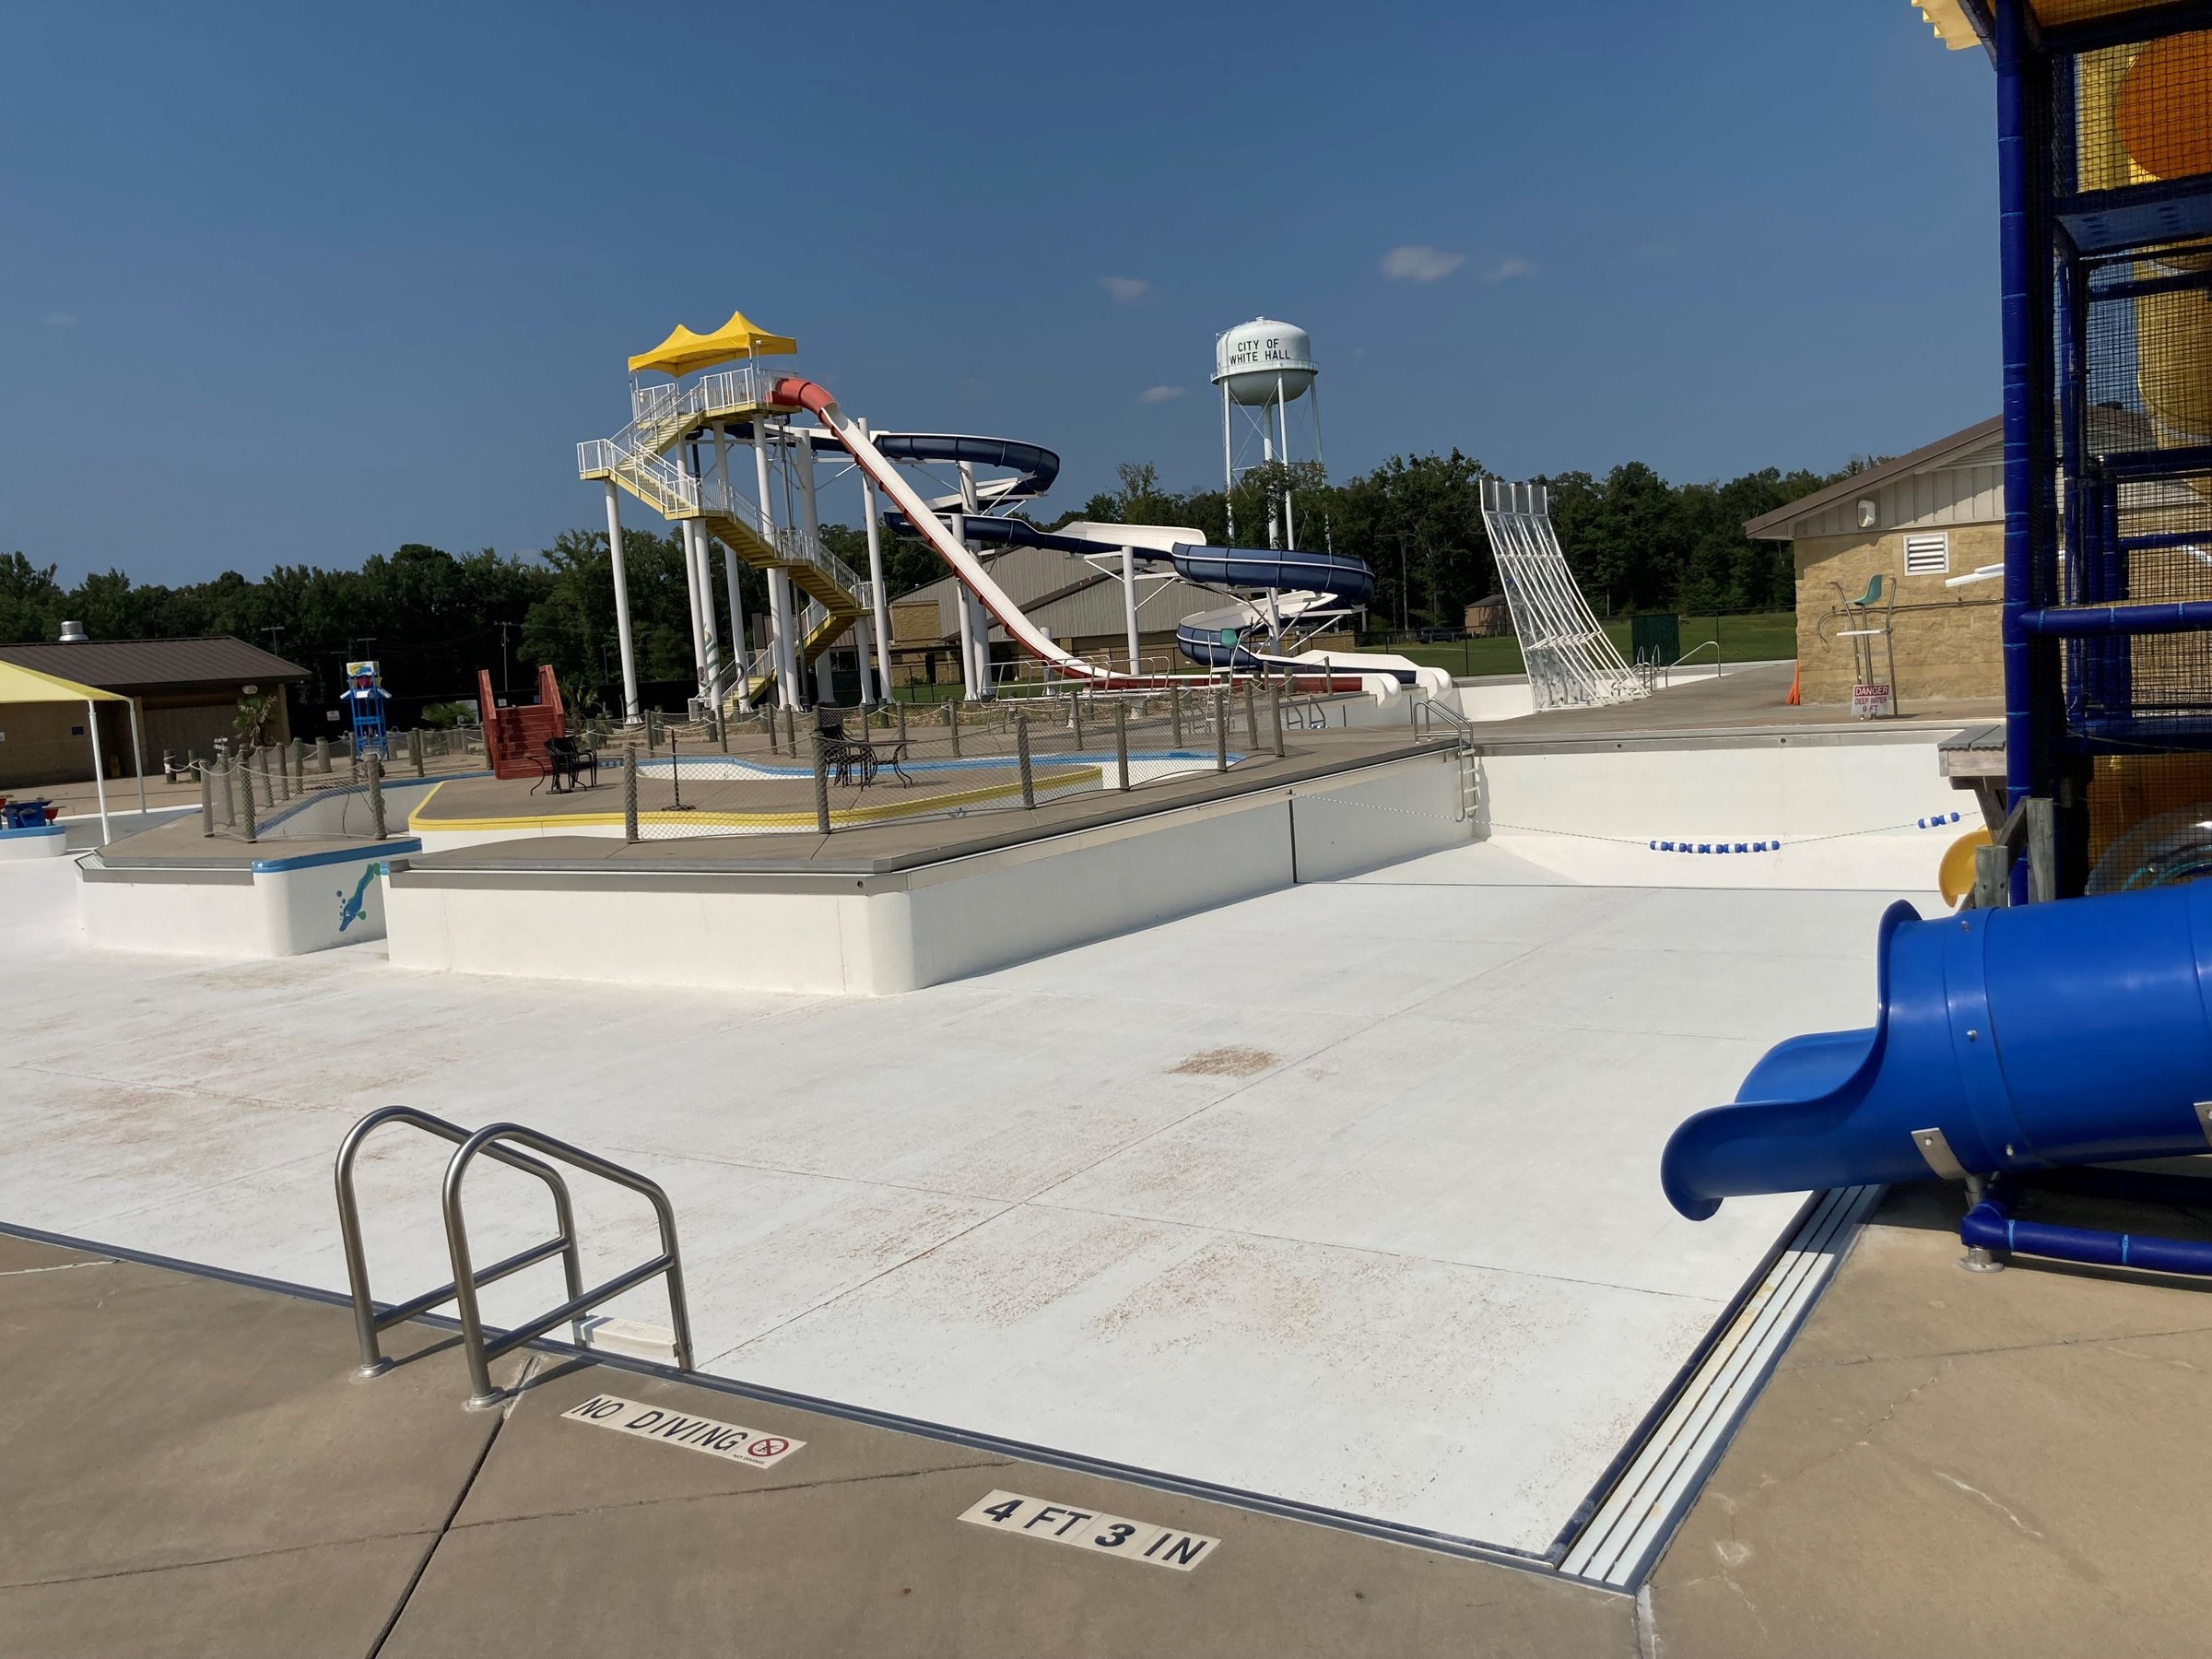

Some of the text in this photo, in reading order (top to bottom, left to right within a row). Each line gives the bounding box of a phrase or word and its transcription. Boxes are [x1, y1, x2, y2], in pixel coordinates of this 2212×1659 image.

[1238, 338, 1279, 352] CITY OF
[1230, 349, 1290, 365] WHITE HALL
[1855, 686, 1888, 696] DANGER
[571, 1397, 748, 1451] NO DIVING
[982, 1499, 1207, 1565] 4 FT 3 IN
